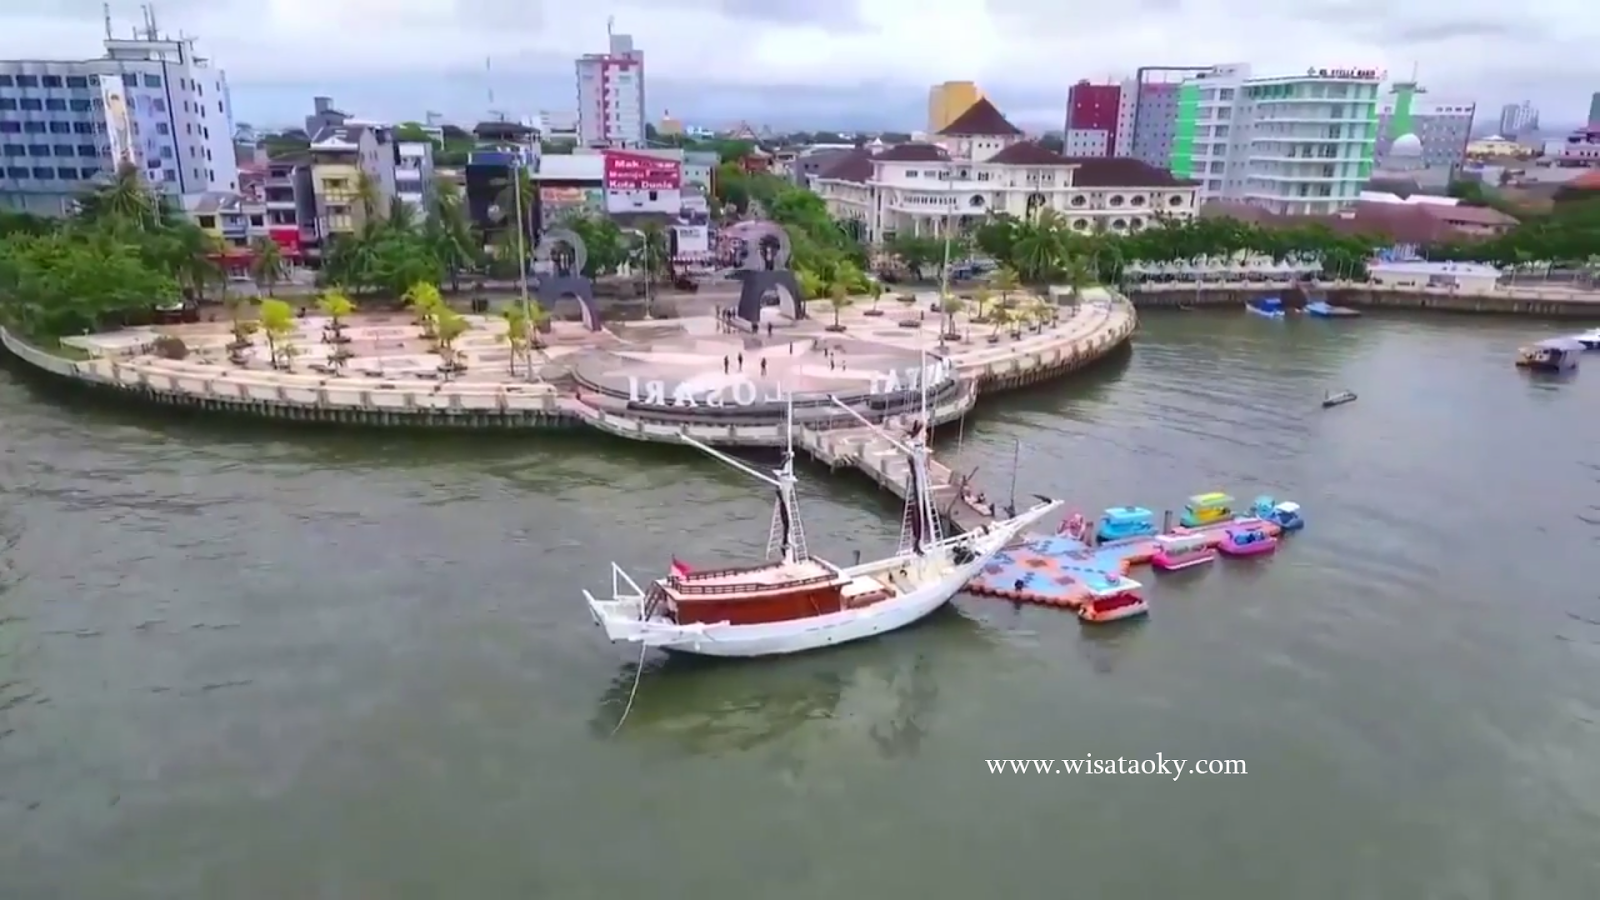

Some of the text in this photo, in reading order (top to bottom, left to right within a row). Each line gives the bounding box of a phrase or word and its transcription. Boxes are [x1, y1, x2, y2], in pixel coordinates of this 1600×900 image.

[614, 159, 676, 169] Maksar
[609, 180, 673, 189] Kota Dunia
